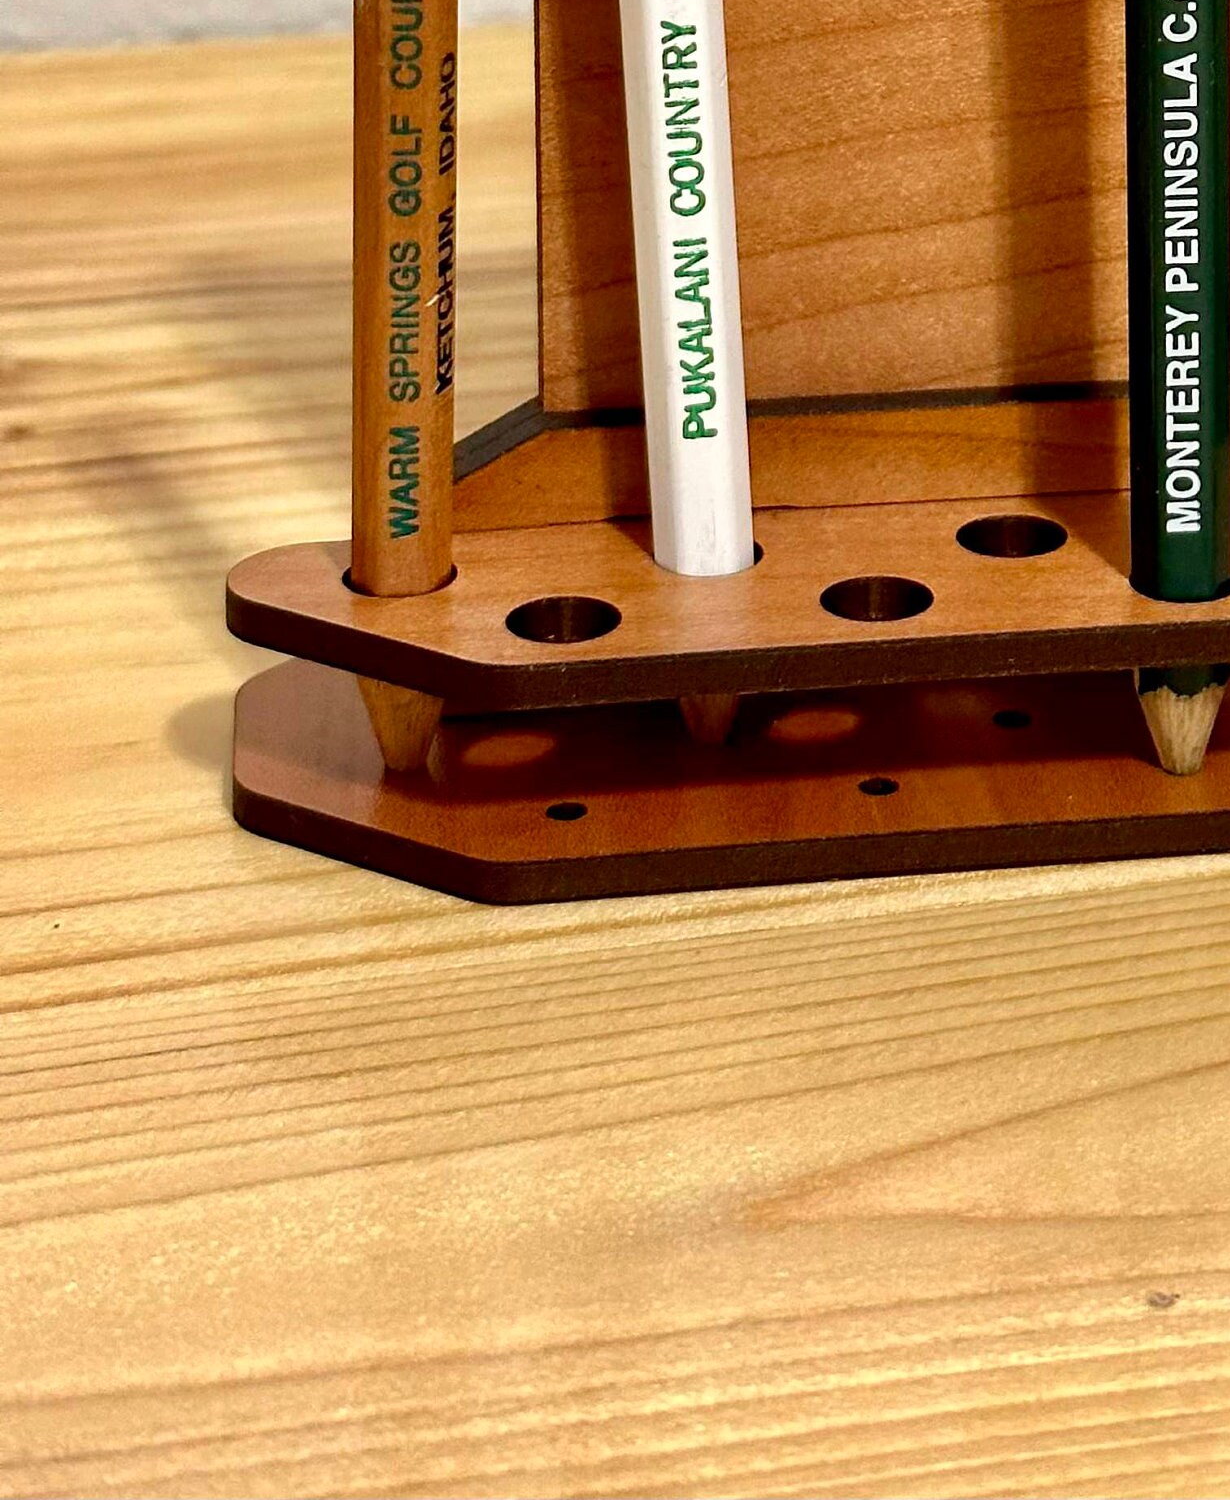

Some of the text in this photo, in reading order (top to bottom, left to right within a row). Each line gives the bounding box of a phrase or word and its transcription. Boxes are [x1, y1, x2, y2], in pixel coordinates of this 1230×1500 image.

[388, 114, 422, 219] GOLF
[438, 51, 455, 177] IDAHO
[661, 21, 706, 217] COUNTRY
[1163, 52, 1199, 294] PENINSULA
[389, 240, 421, 403] SPRINGS
[672, 236, 718, 439] PUKALANI
[390, 425, 420, 540] WARM
[1166, 304, 1201, 536] MONTEREY
